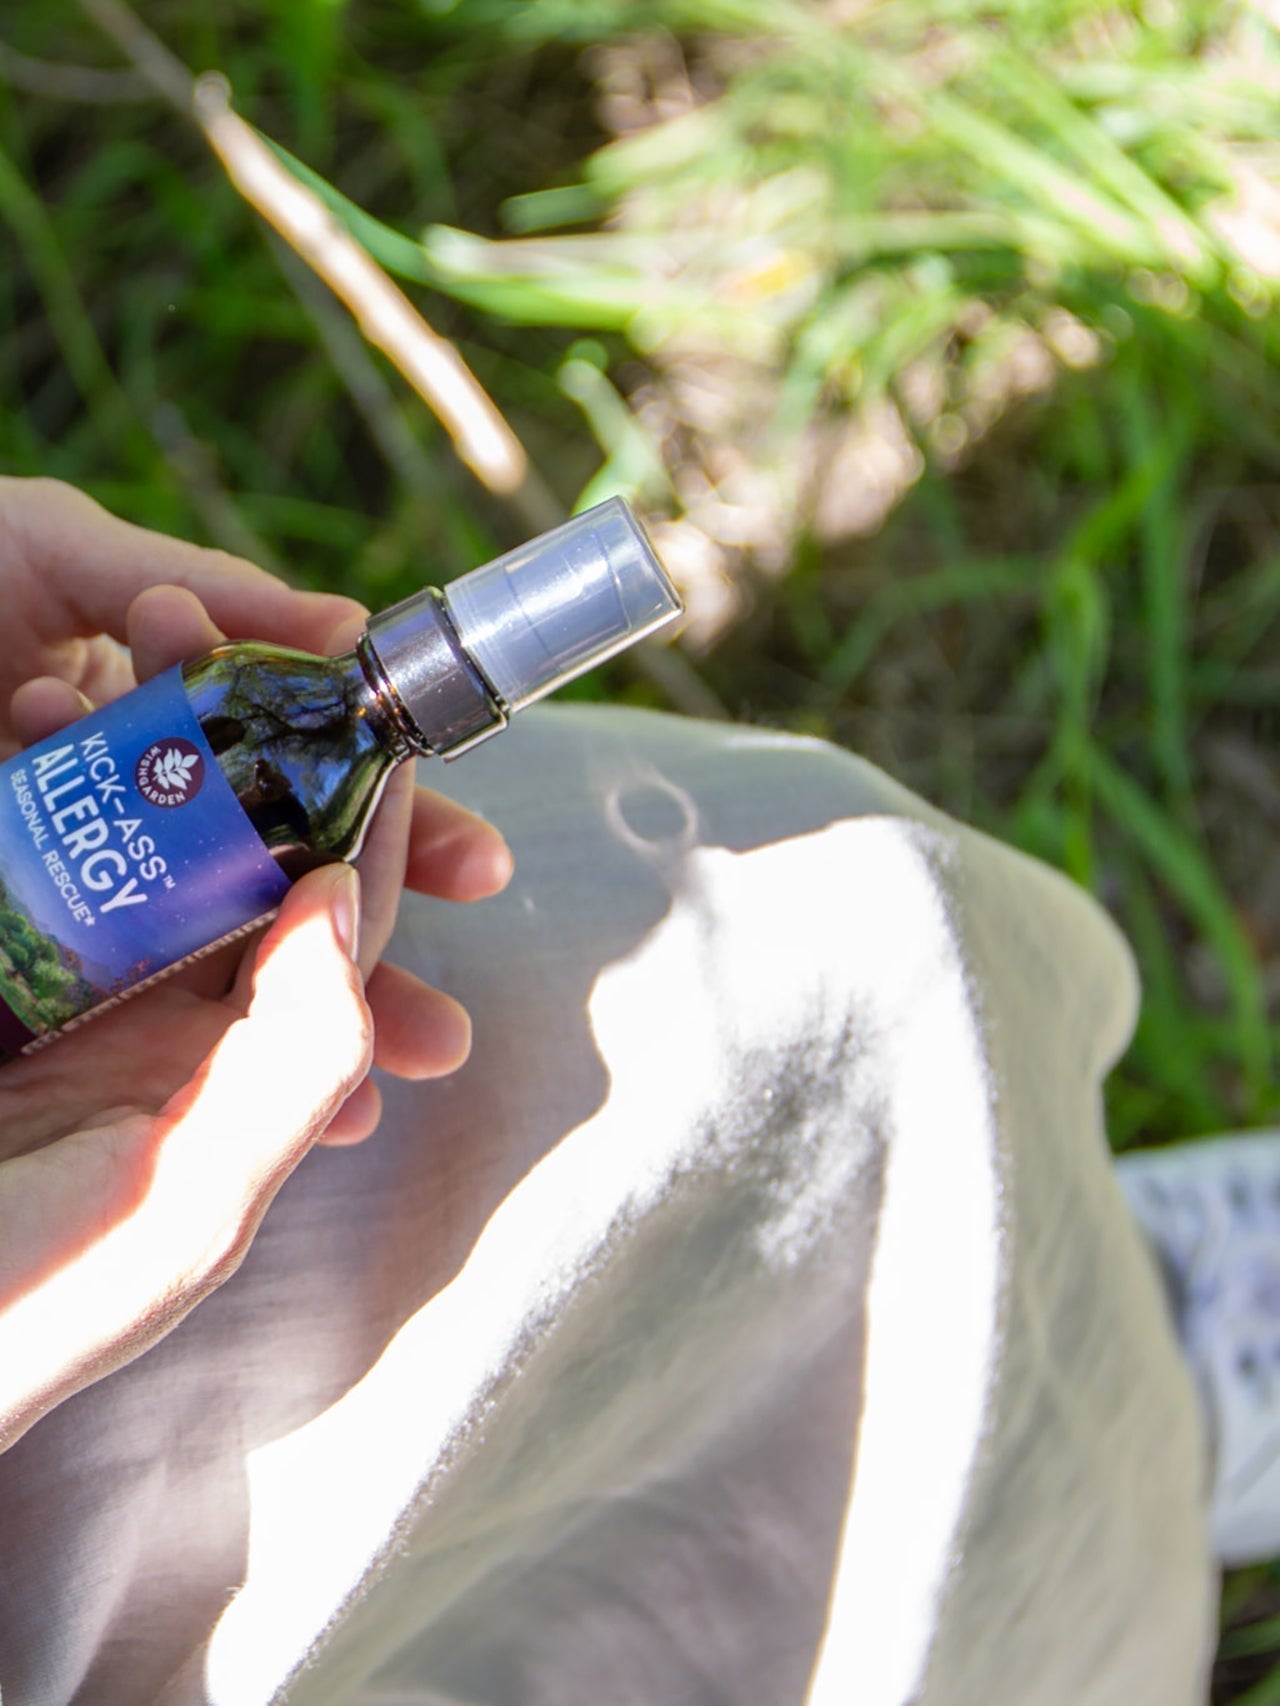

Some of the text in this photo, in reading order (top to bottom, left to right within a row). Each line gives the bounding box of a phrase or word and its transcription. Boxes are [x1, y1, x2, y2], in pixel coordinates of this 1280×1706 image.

[11, 768, 50, 850] SEASONAL
[138, 745, 186, 806] WISHGARDEN
[31, 743, 148, 913] ALLERGY
